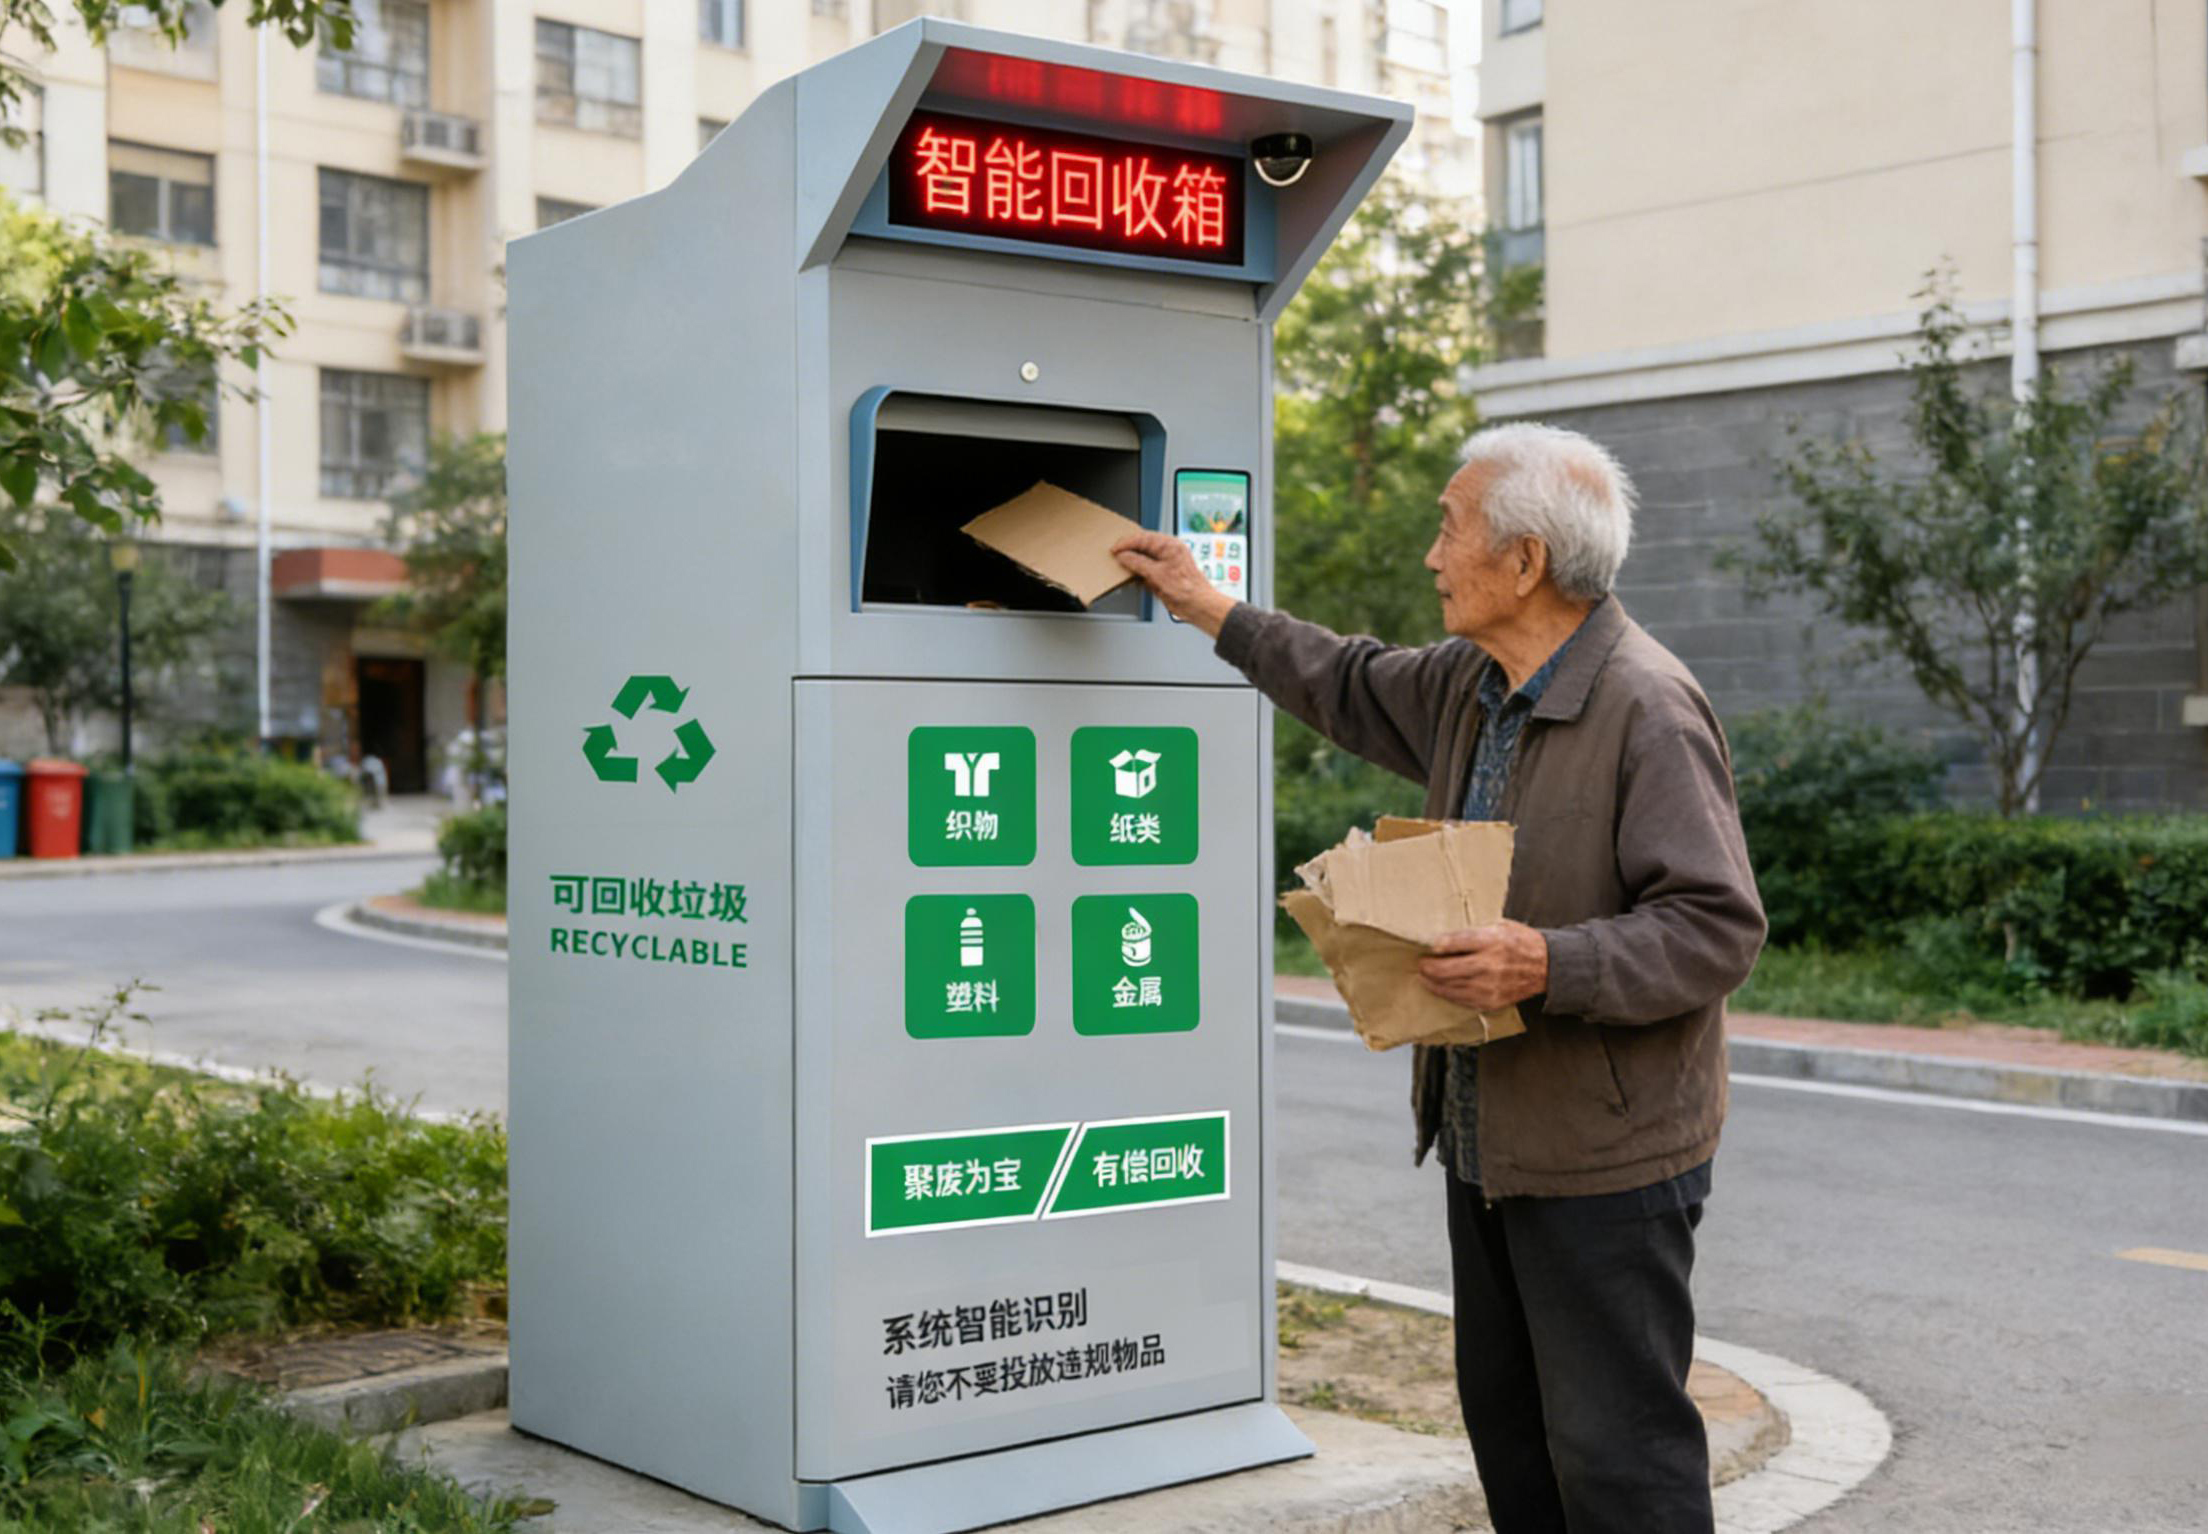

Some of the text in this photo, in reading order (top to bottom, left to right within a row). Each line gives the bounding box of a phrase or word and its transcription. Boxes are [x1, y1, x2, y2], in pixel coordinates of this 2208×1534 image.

[914, 126, 1227, 247] 智能回收箱
[945, 809, 999, 841] 织物
[1109, 812, 1161, 844] 纸类
[549, 874, 748, 924] 可回收垃圾
[550, 927, 747, 969] RECYCLABLE
[945, 979, 1000, 1013] 塑料
[1111, 975, 1163, 1008] 金属
[903, 1157, 1022, 1201] 聚废为宝
[1092, 1143, 1206, 1188] 有偿回收
[882, 1287, 1088, 1356] 系统智能识别
